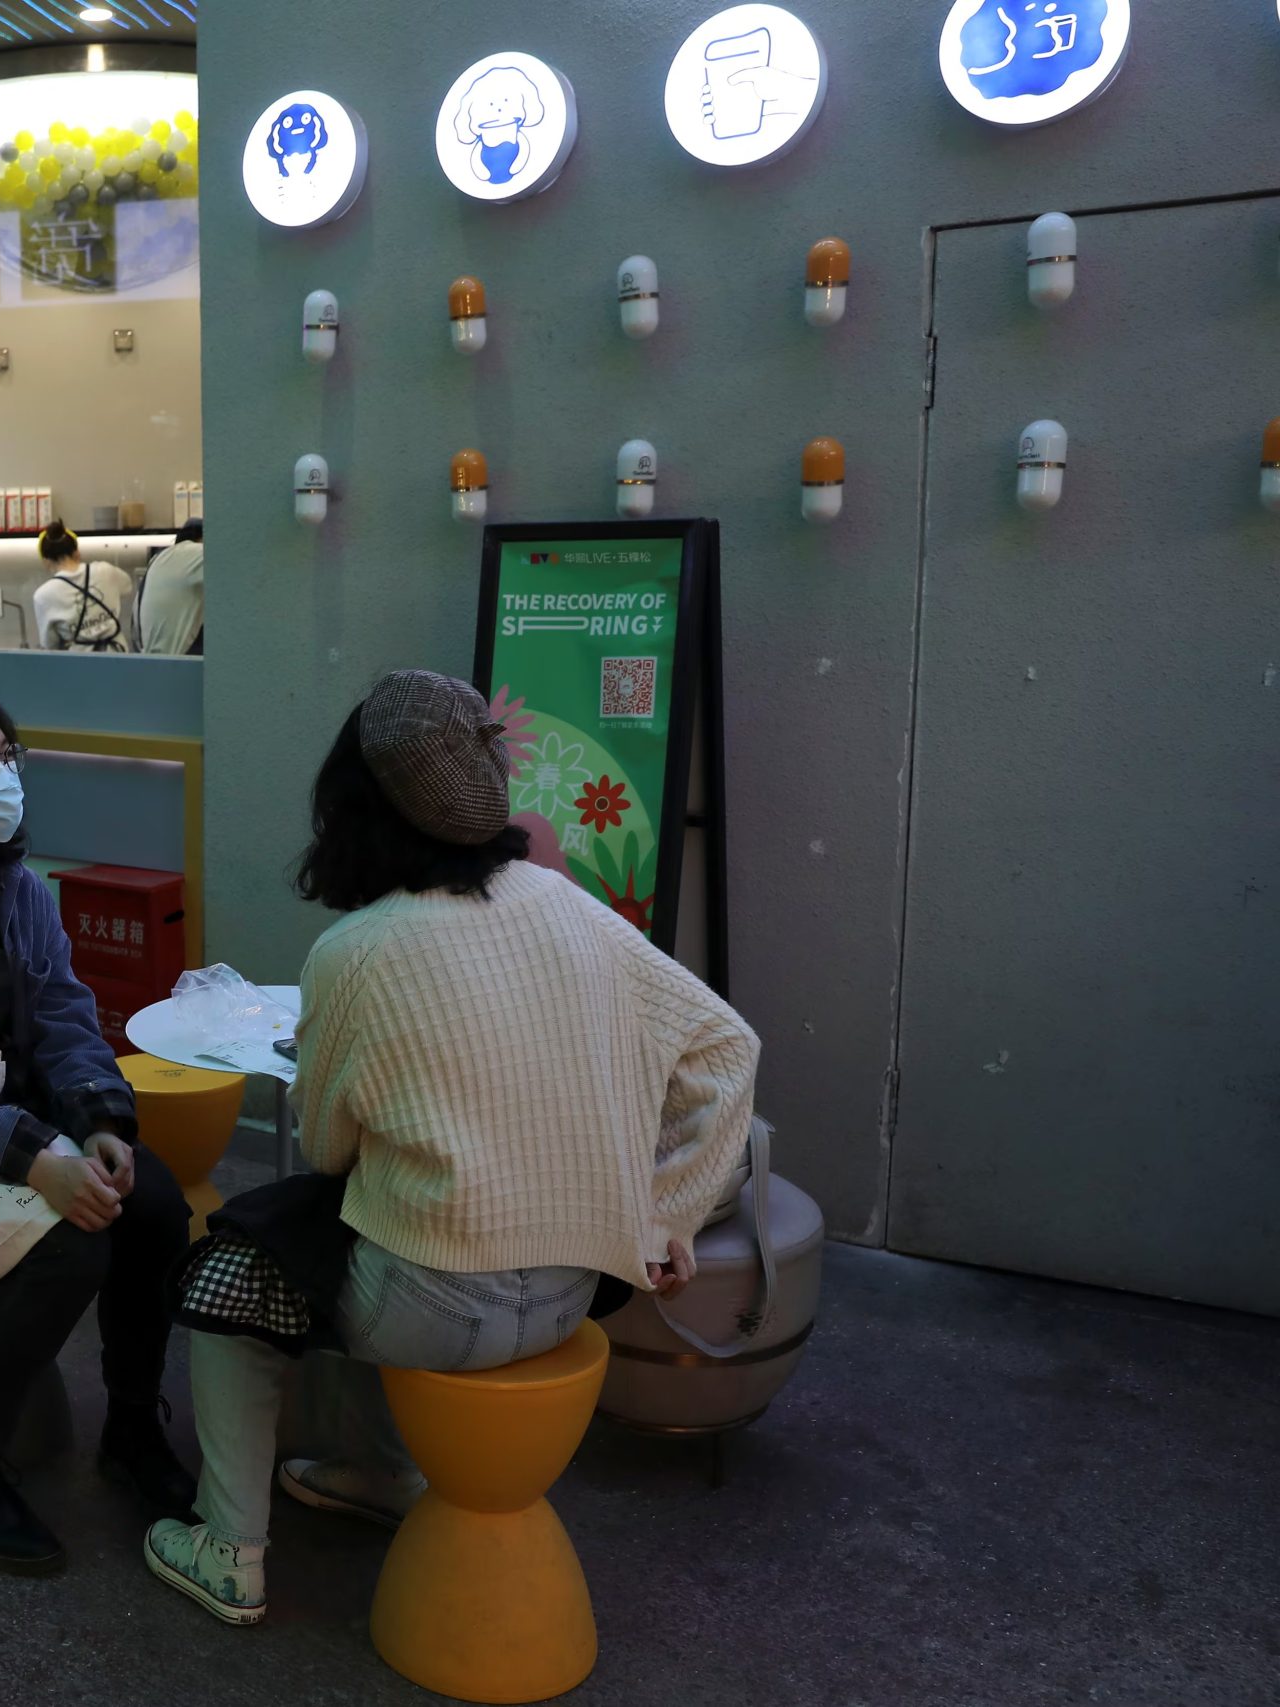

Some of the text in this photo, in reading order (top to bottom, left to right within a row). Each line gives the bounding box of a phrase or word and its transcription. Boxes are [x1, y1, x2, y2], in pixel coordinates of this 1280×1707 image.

[502, 592, 667, 610] THE RECOVERY OF
[501, 614, 648, 636] SPRING
[534, 762, 562, 791] 春
[559, 822, 589, 857] 风
[77, 912, 145, 945] 灭火器箱
